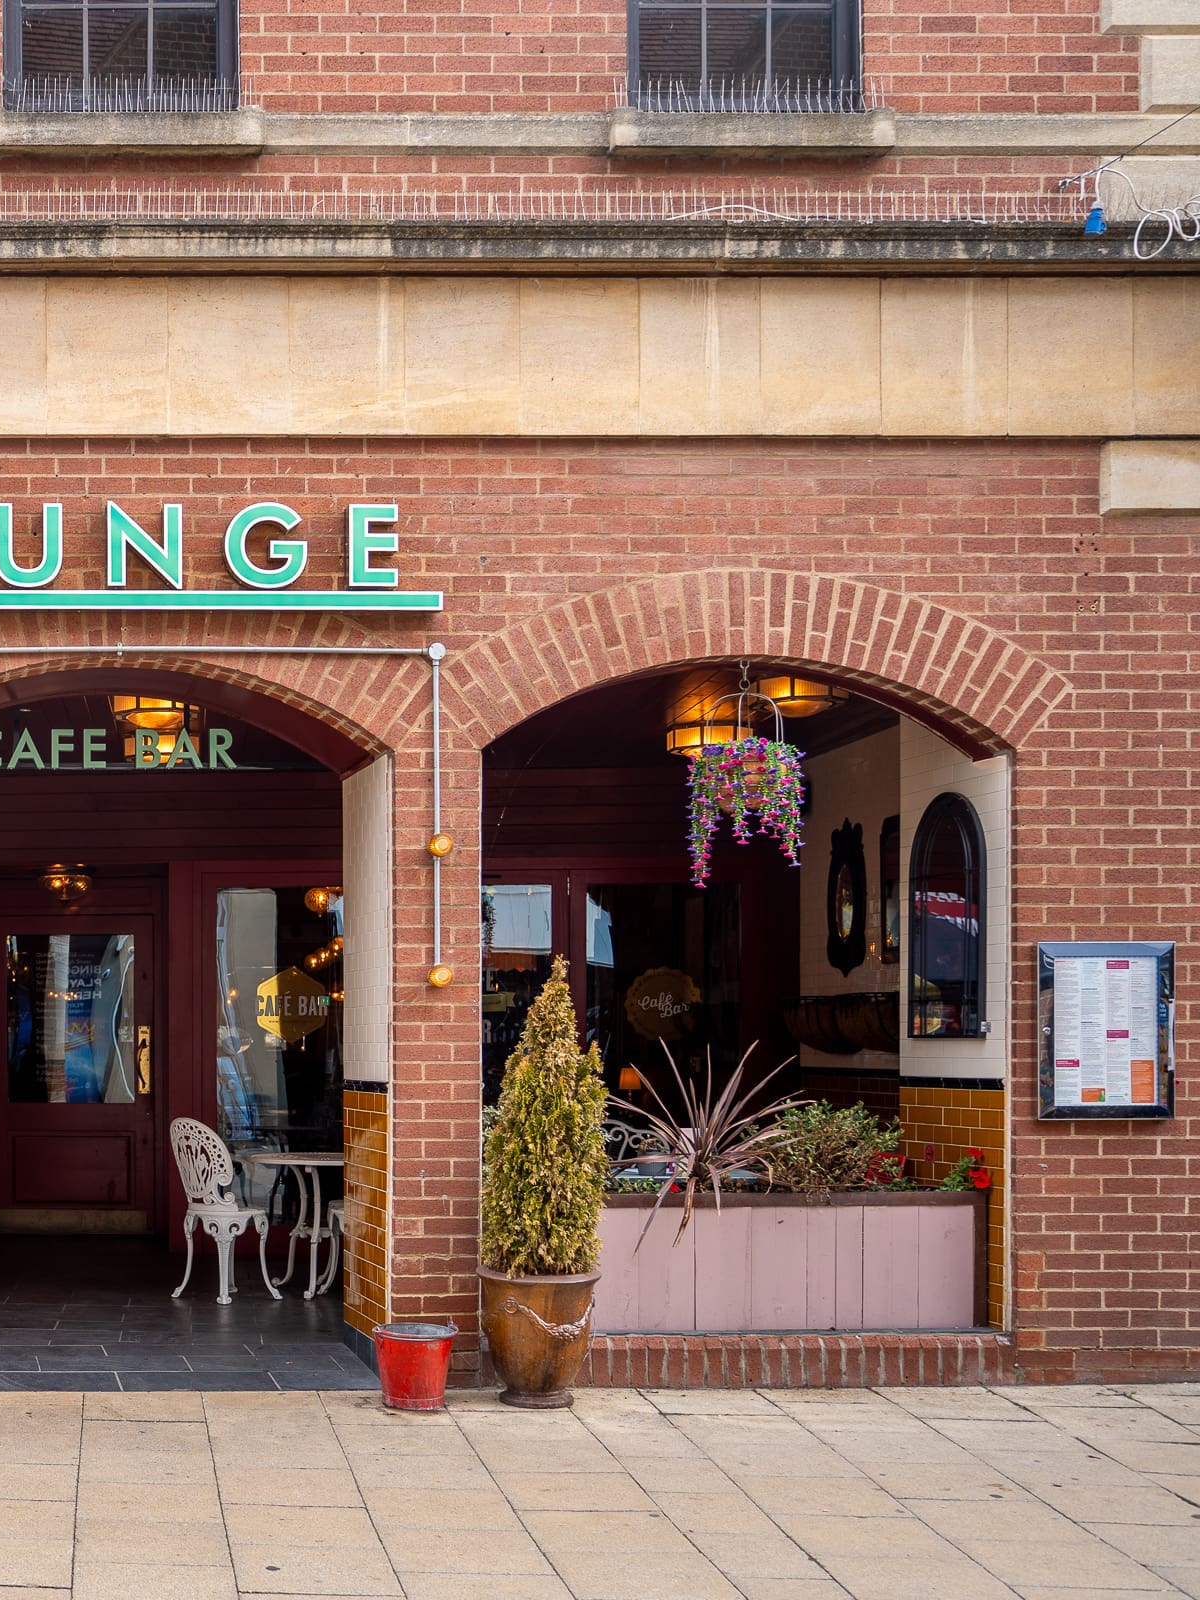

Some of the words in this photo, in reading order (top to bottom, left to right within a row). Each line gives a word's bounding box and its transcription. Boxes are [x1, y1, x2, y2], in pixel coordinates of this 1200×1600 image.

[134, 727, 238, 770] BAR
[256, 990, 292, 1017] CAFÉ
[298, 995, 328, 1017] BAR
[637, 991, 673, 1011] Café
[659, 1002, 690, 1018] Bar
